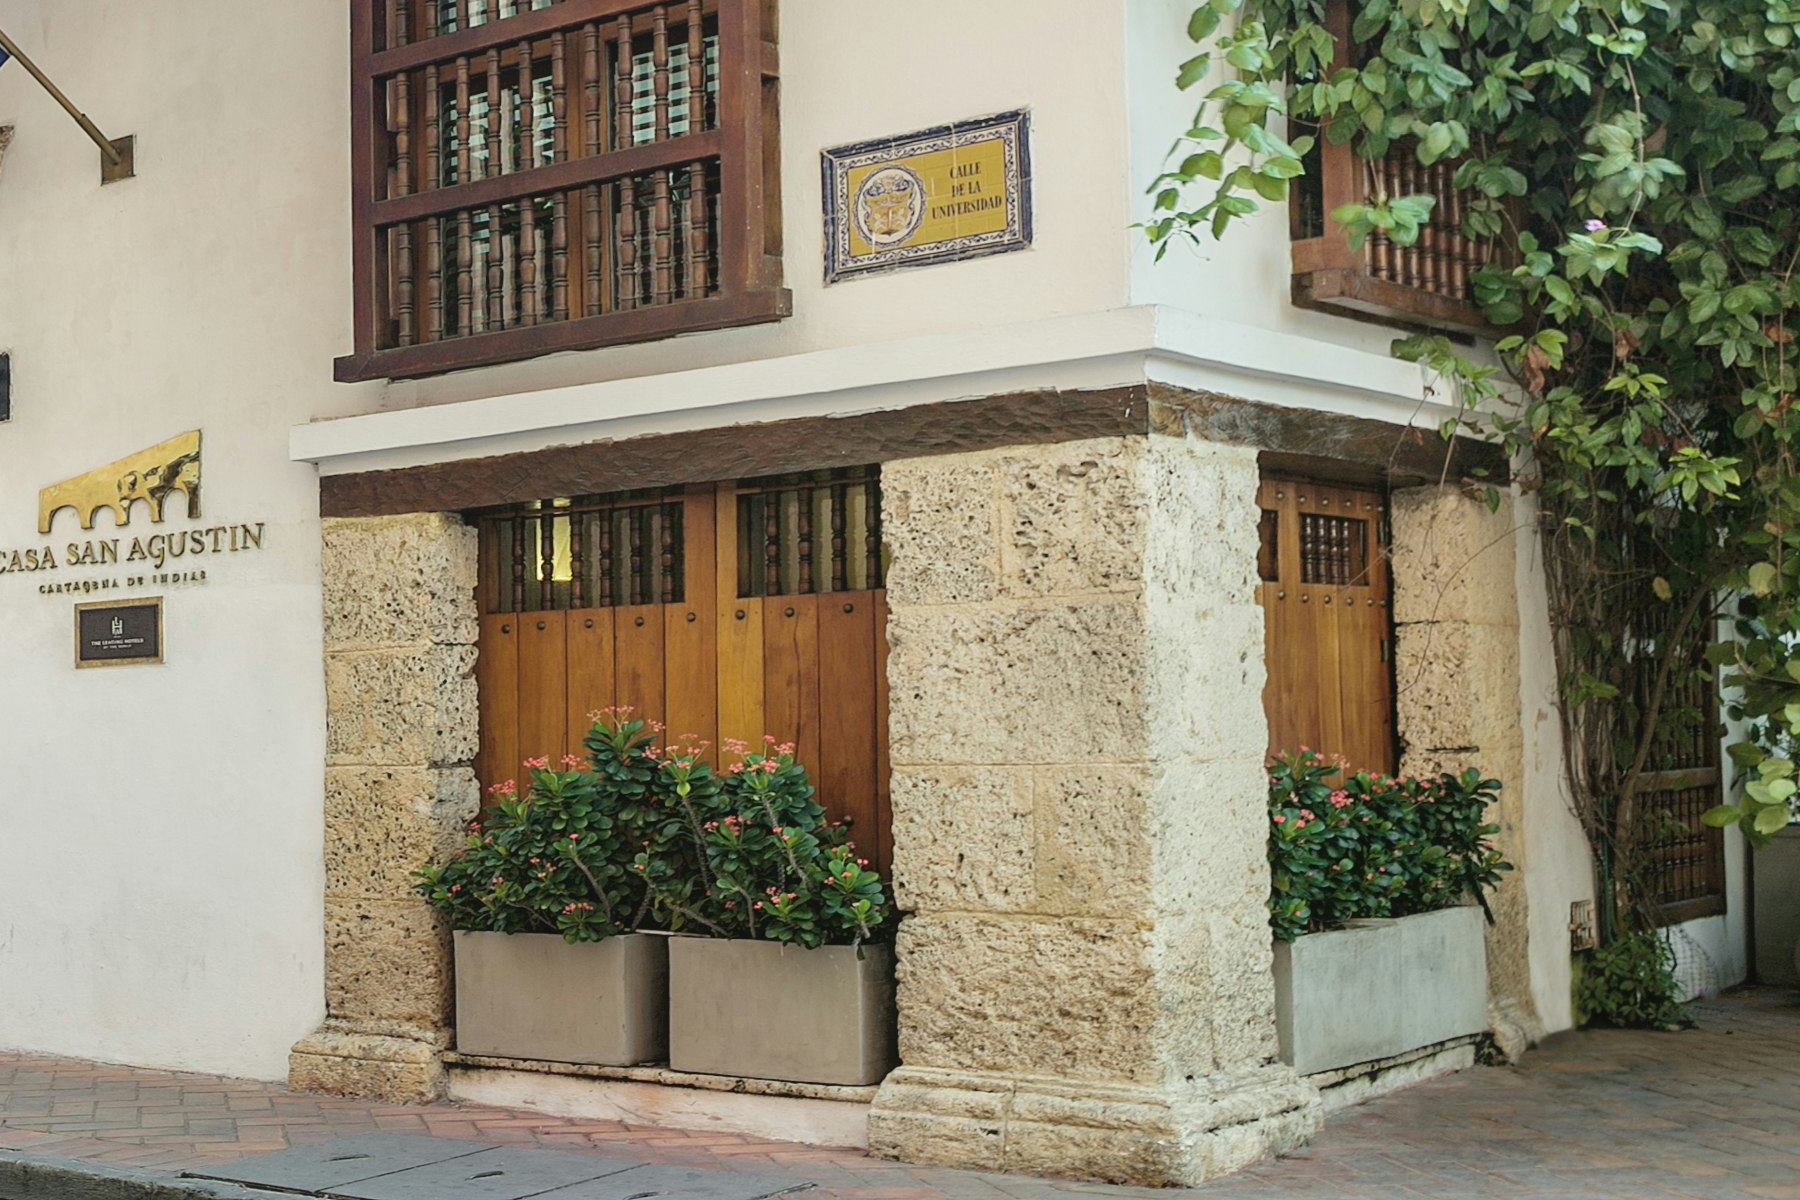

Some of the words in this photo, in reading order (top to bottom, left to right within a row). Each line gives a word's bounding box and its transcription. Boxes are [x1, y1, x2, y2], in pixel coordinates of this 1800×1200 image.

[950, 162, 981, 179] CALLE
[952, 184, 965, 197] DE
[969, 181, 981, 194] LA
[932, 196, 1002, 219] UNIVERSIDAD
[66, 539, 120, 566] SAN
[126, 522, 266, 569] AGUSTIN
[38, 578, 119, 594] CARTAGENA
[127, 576, 145, 587] DE
[152, 570, 207, 585] INDIAS
